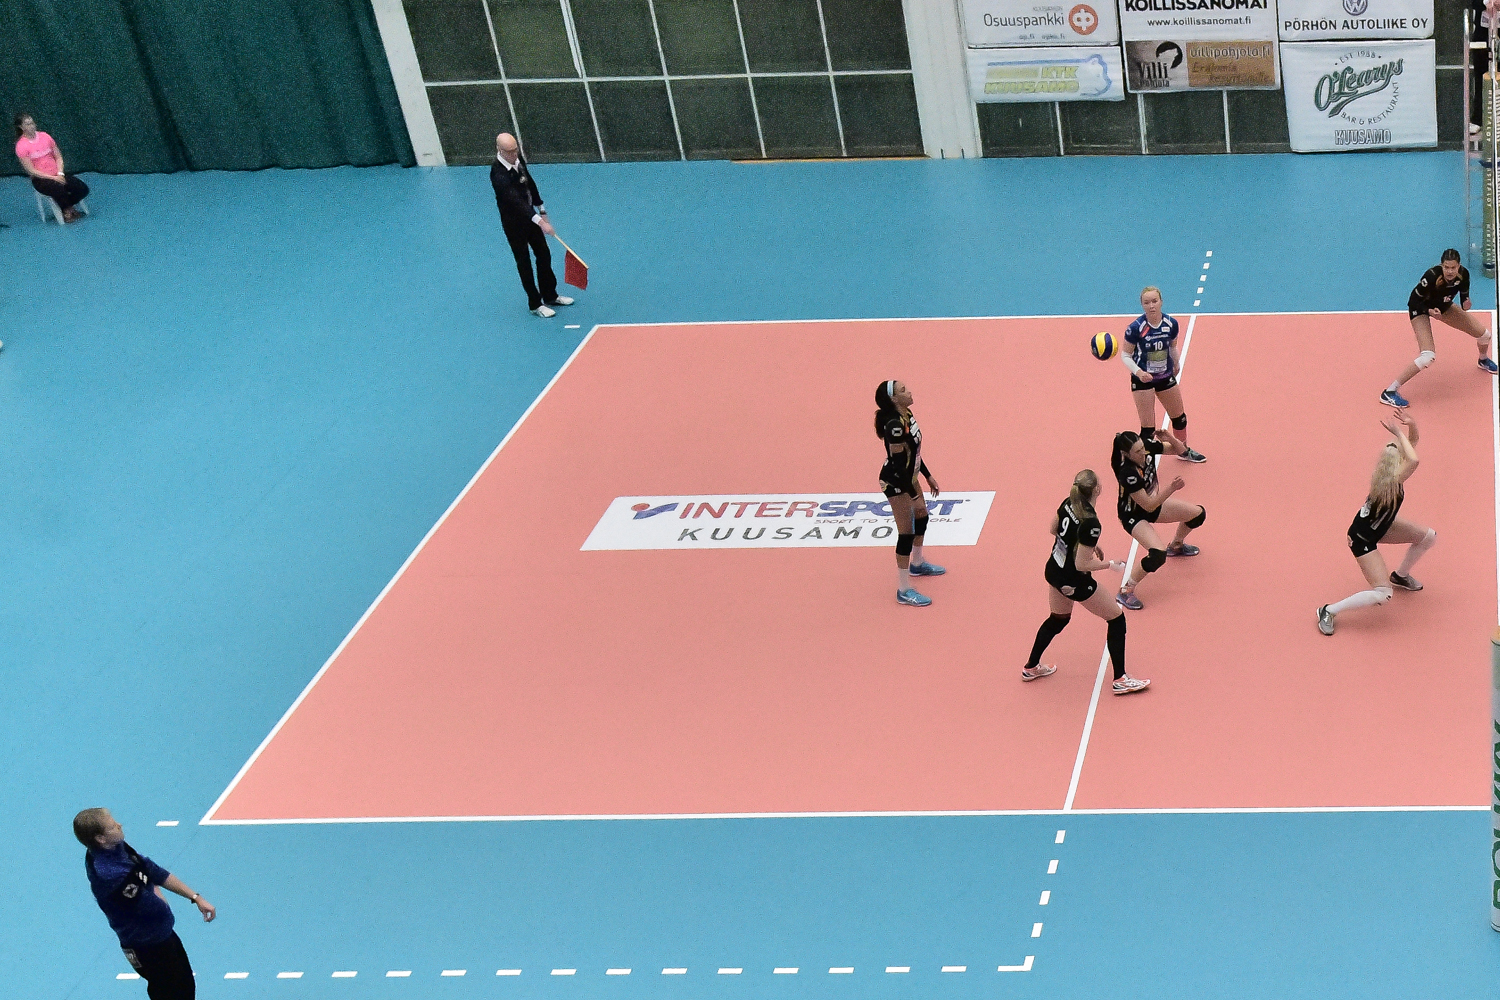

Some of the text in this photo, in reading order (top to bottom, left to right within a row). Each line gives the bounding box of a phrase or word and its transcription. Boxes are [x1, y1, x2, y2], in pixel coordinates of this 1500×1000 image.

[984, 13, 1064, 29] Osuuspankki
[1147, 16, 1251, 26] www.koillissanomat.fi
[1285, 18, 1428, 31] PÖRHÖN AUTOLIIKE OY
[1339, 52, 1353, 64] EST
[1041, 66, 1079, 78] KTK
[1138, 62, 1168, 79] Villi
[984, 80, 1080, 94] KUUSAMO
[1340, 111, 1357, 124] BAR
[1368, 81, 1400, 125] RESTAURANT
[1335, 129, 1392, 145] KUUSAMO
[1153, 341, 1163, 351] 10
[677, 525, 894, 542] KUUSAMO
[1060, 517, 1070, 537] 9
